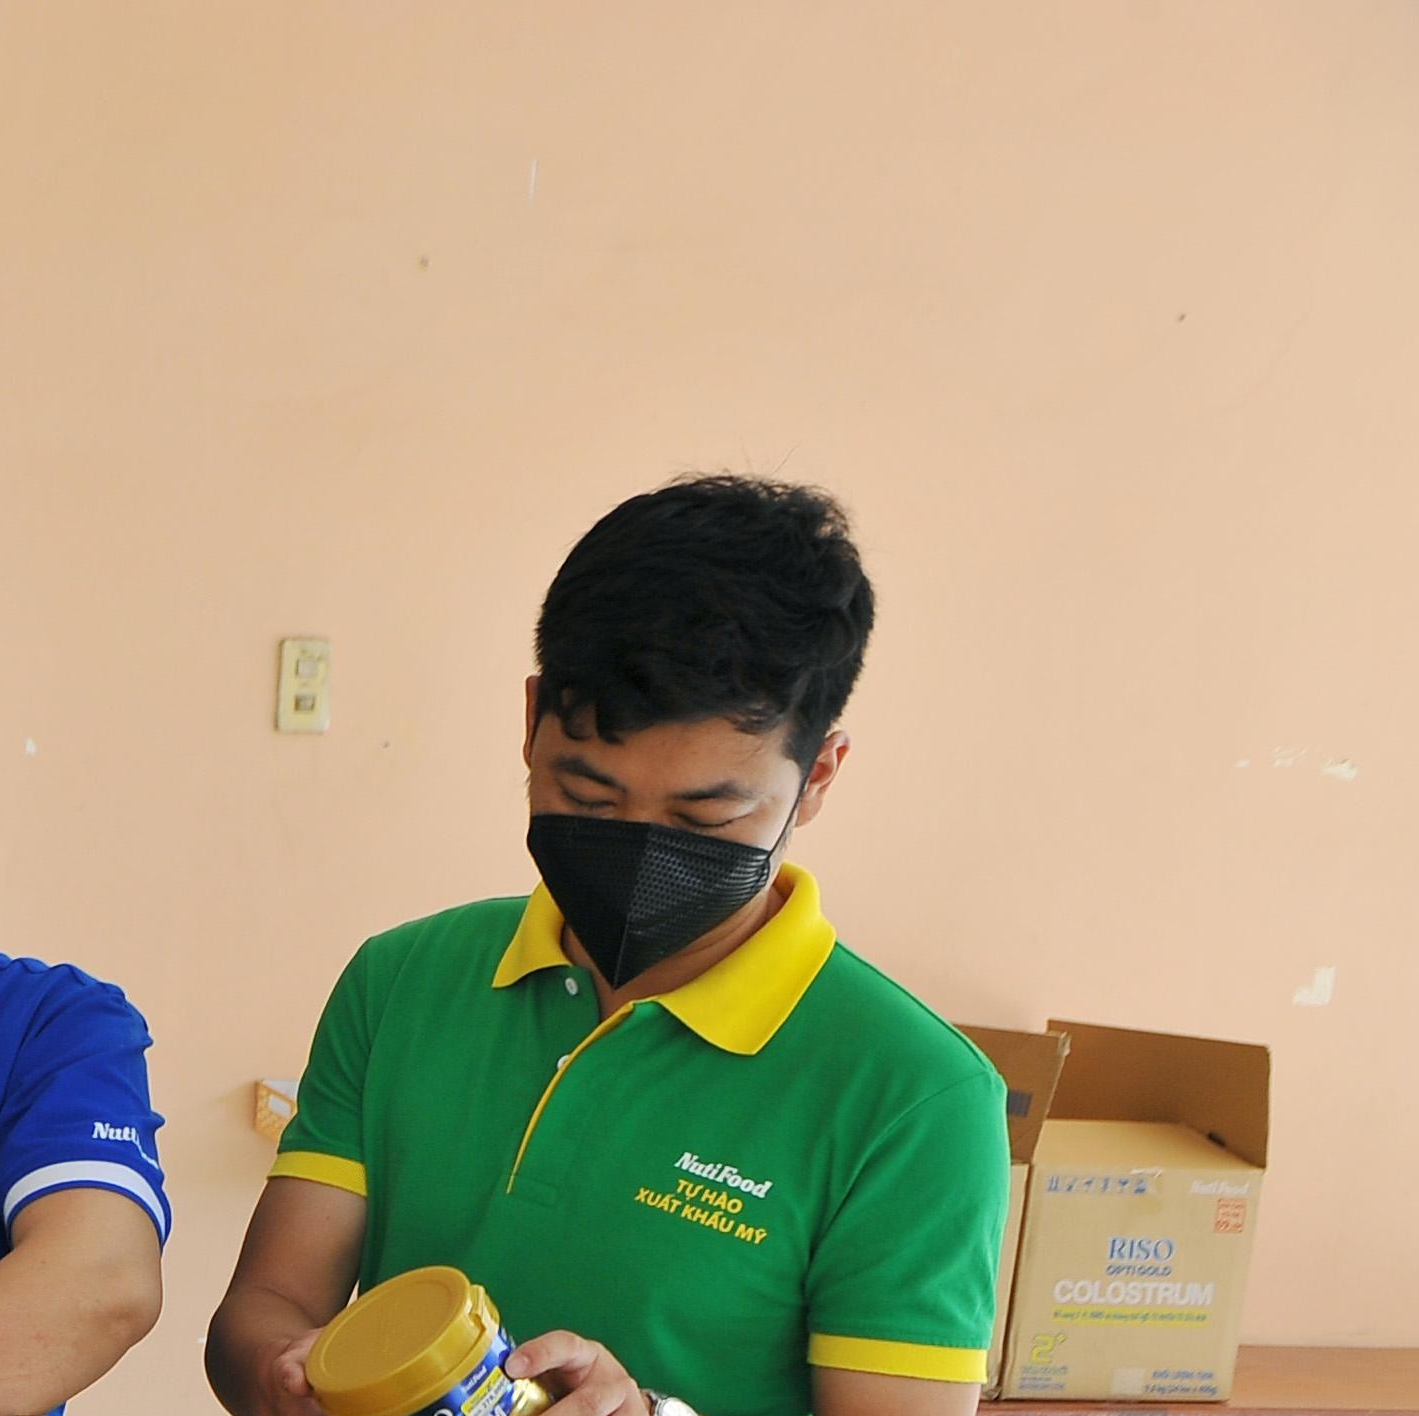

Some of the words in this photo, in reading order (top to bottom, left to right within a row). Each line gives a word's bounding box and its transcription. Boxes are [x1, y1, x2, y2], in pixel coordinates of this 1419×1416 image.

[674, 1152, 773, 1198] NutiFood
[676, 1179, 703, 1200] TỰ
[701, 1189, 743, 1214] HÀO
[635, 1187, 681, 1213] XUẤT
[735, 1224, 767, 1244] MỸ
[1108, 1238, 1176, 1261] RISO
[1054, 1281, 1215, 1305] COLOSTRUM
